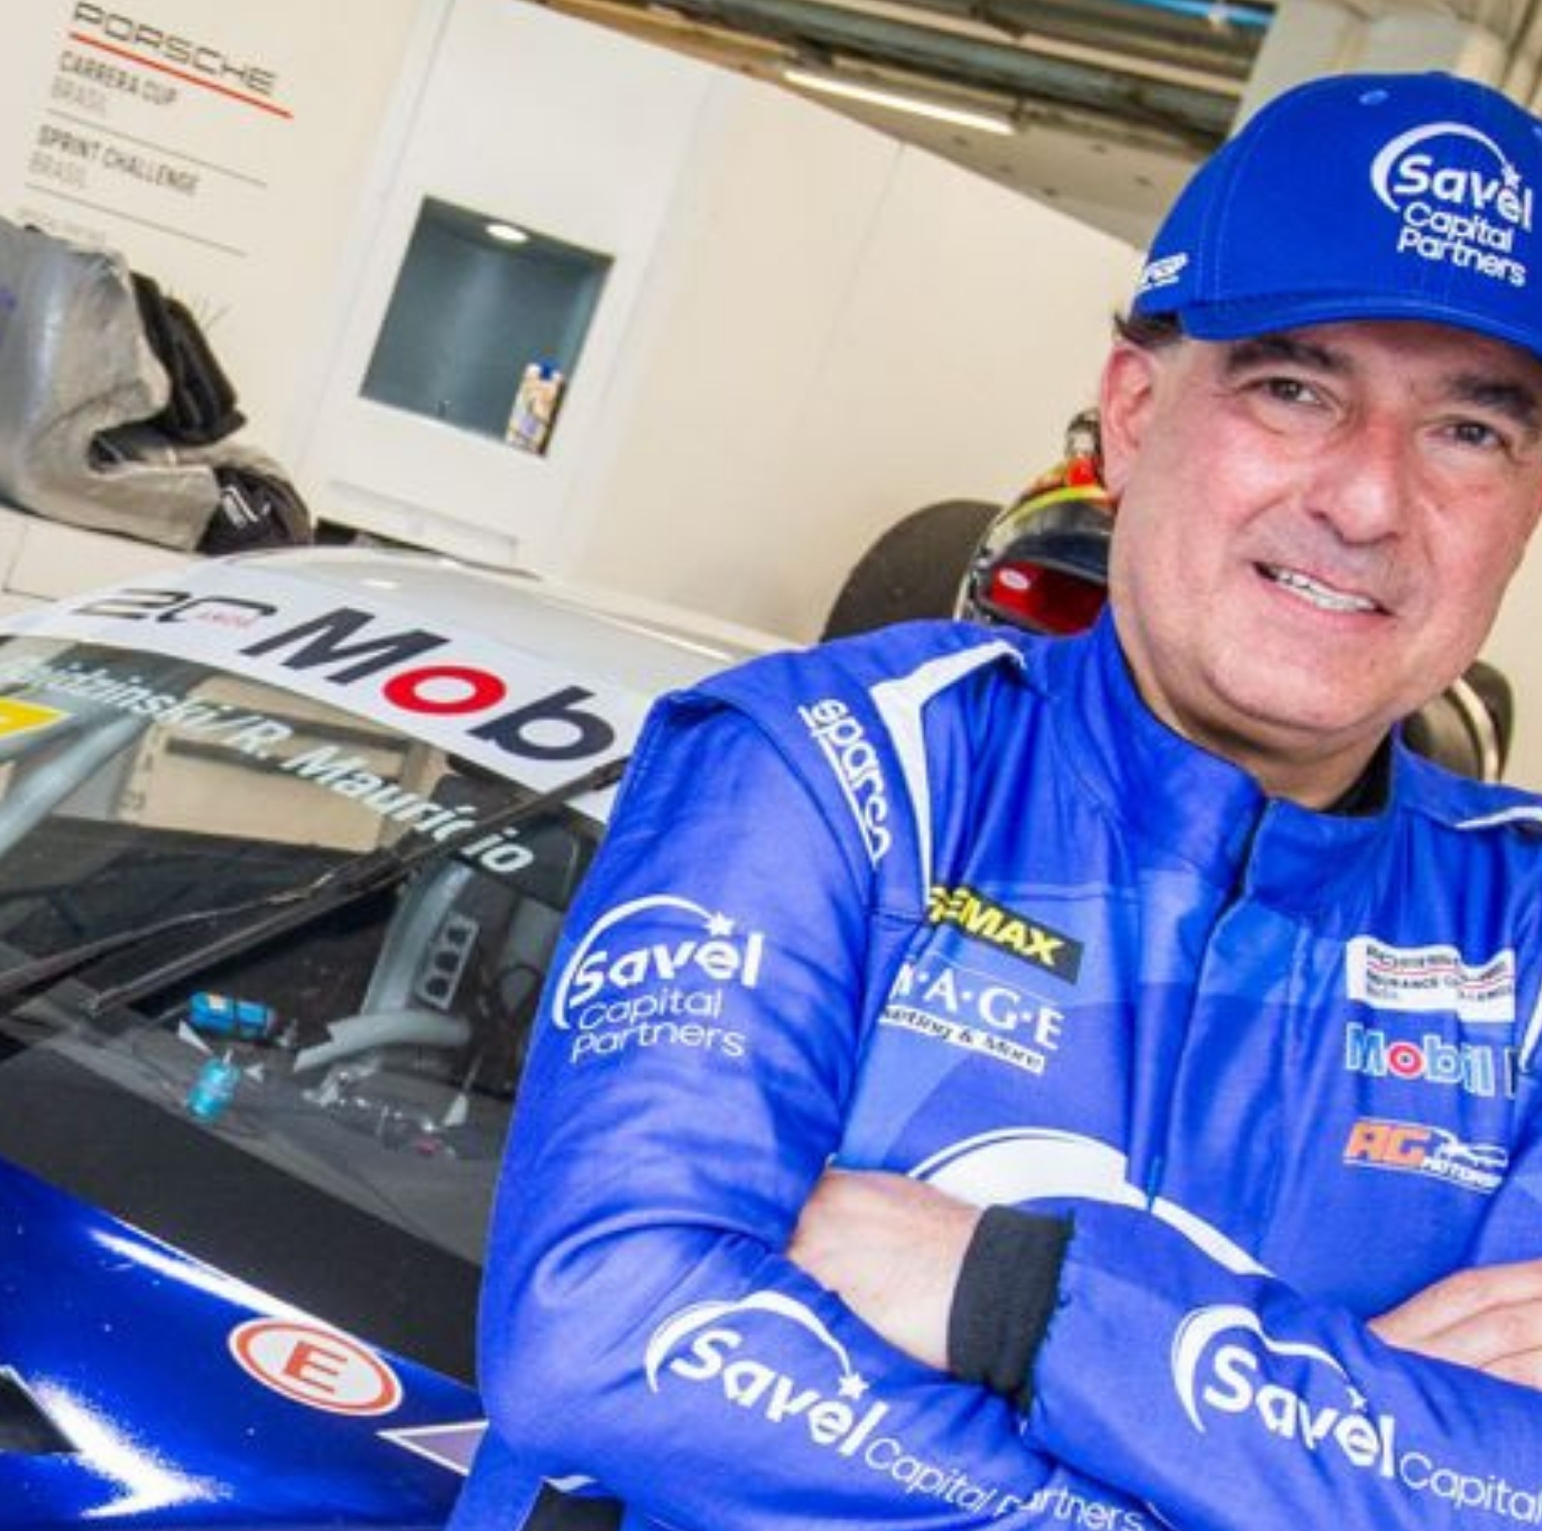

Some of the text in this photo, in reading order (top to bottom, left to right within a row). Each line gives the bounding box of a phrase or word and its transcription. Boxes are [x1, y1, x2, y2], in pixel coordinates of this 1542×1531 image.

[59, 50, 178, 105] CARRERA CUP
[72, 1, 276, 97] PORSCHE
[37, 124, 200, 195] SPRINT CHALLENGE
[1397, 230, 1527, 289] Partners
[1403, 201, 1514, 252] Capital
[240, 607, 616, 762] Mob
[803, 698, 892, 868] sparco
[569, 930, 764, 1006] Savel
[571, 1014, 746, 1063] Partners
[579, 988, 723, 1031] Capital
[1345, 1022, 1495, 1096] Mobil
[282, 1340, 350, 1395] E
[669, 1329, 888, 1456] Savel
[864, 1437, 998, 1514] Capital
[1202, 1345, 1396, 1478] Savel
